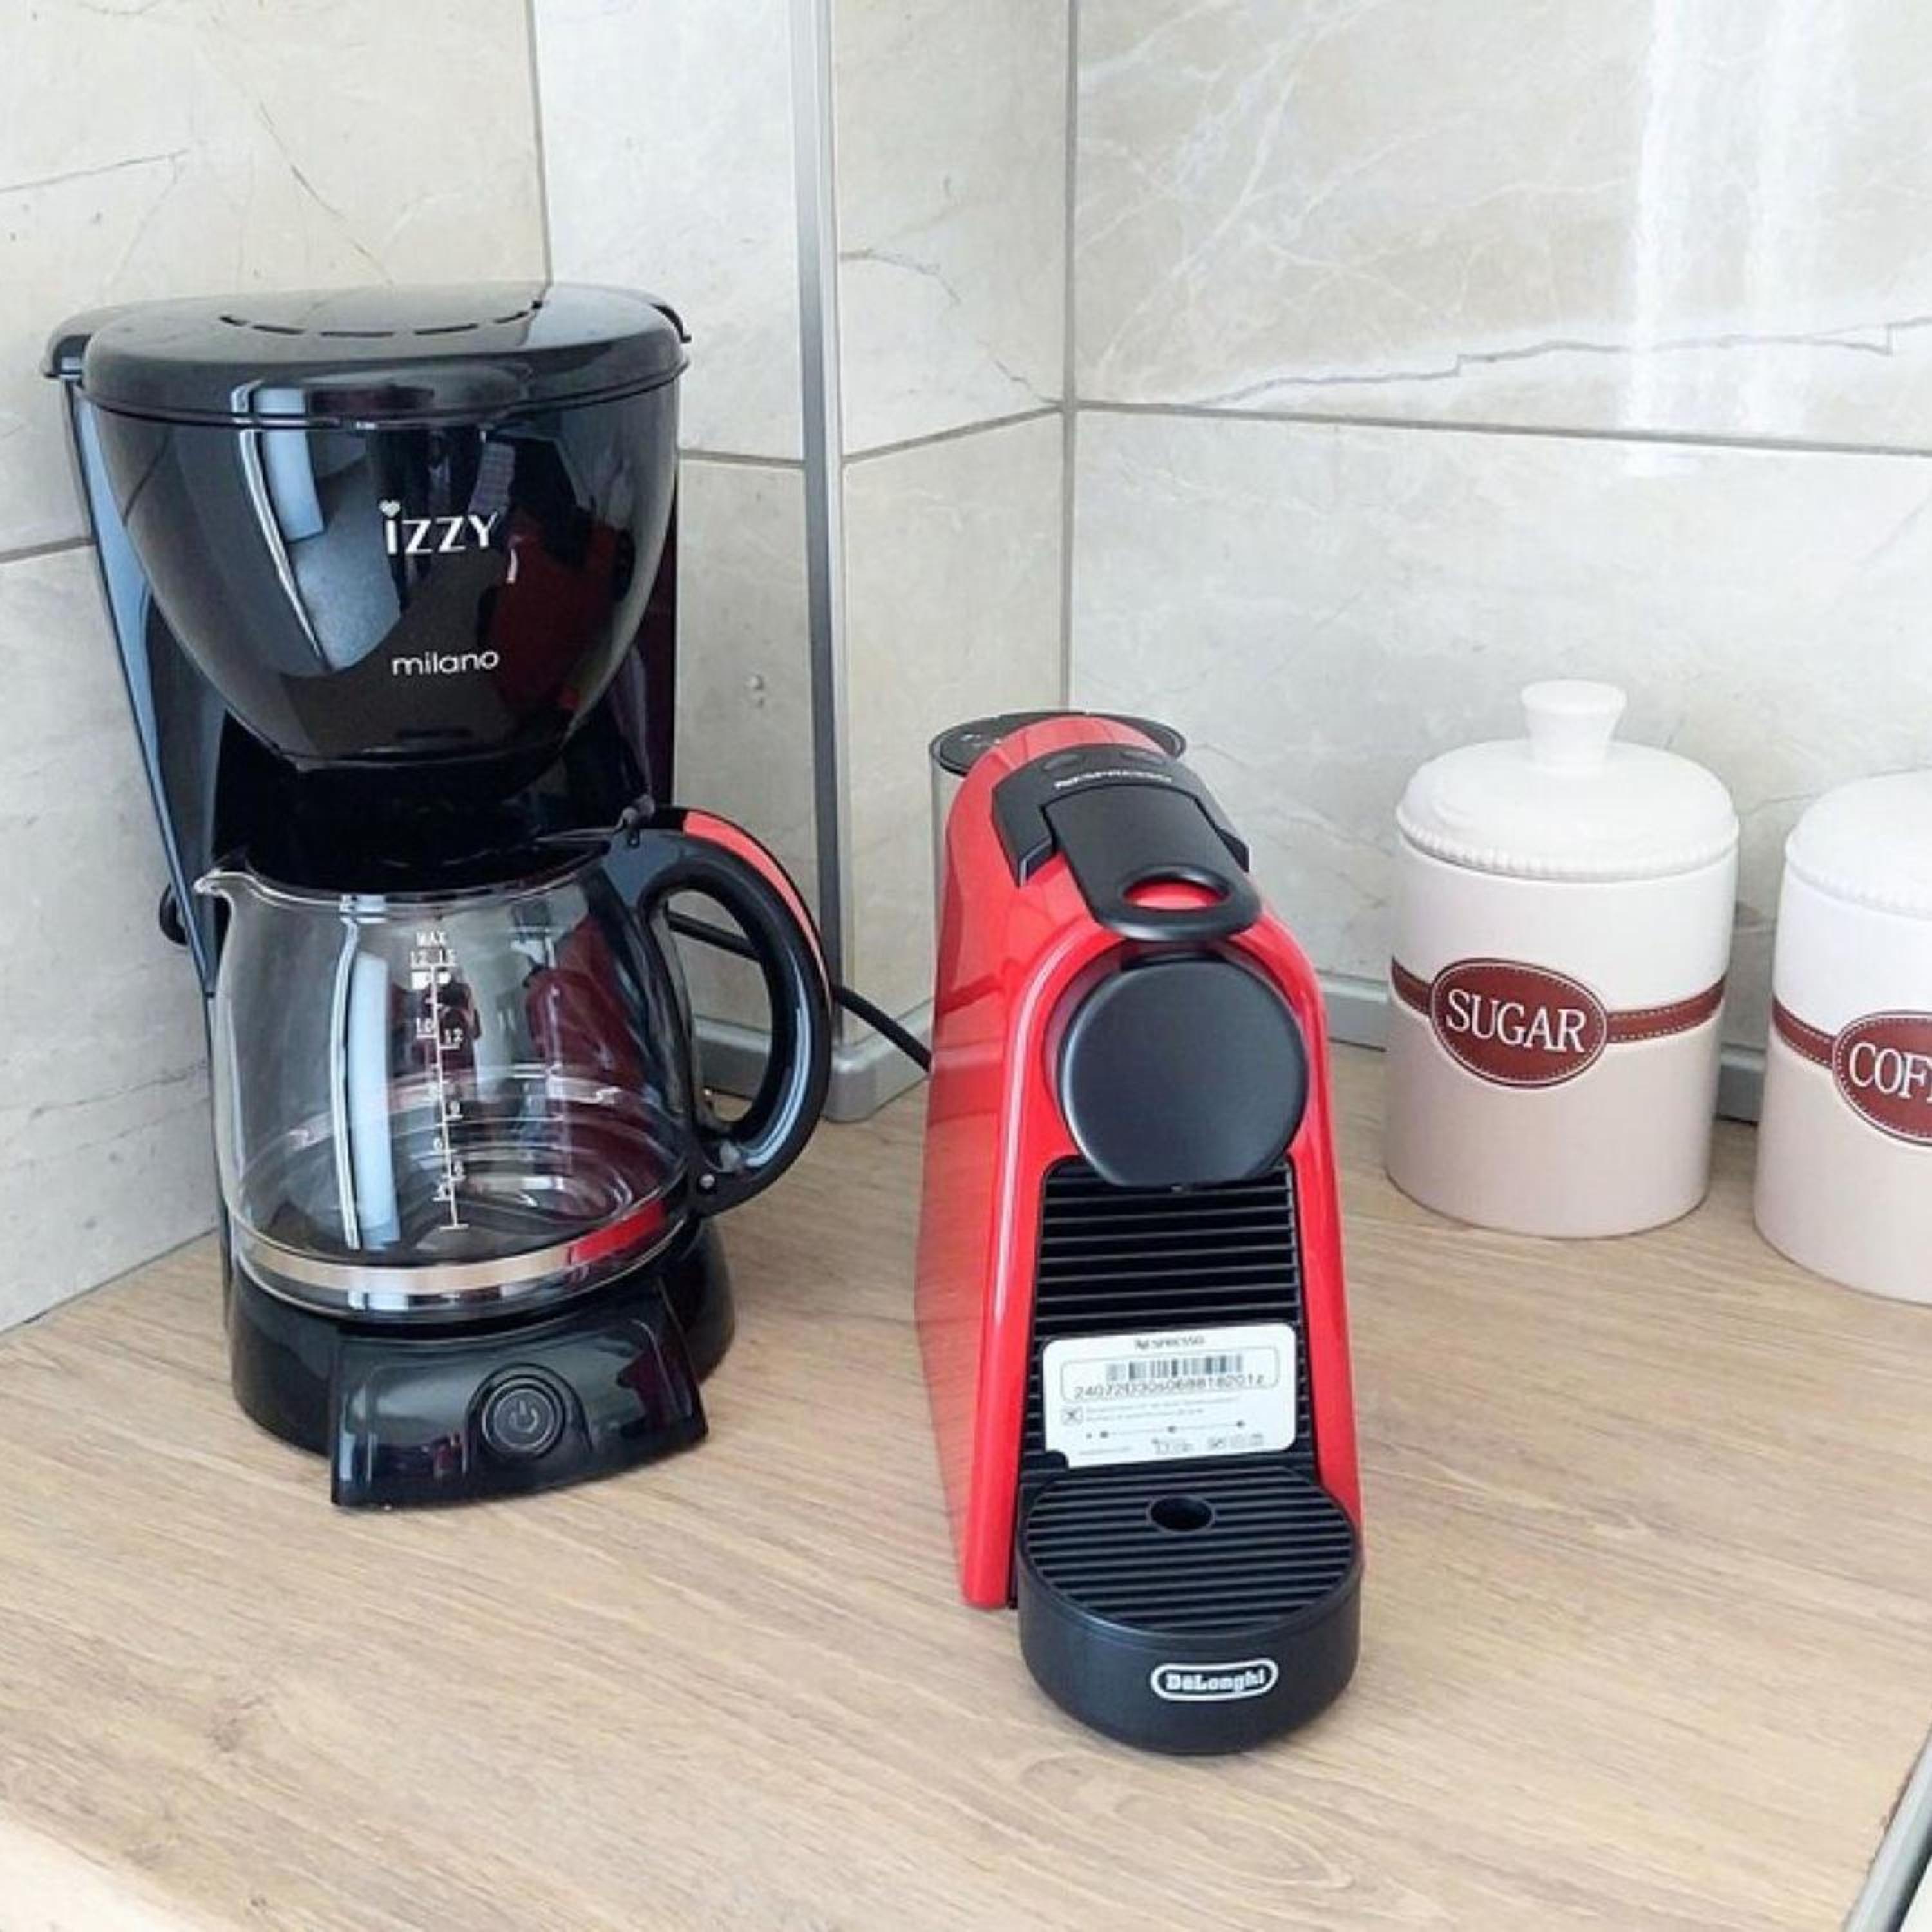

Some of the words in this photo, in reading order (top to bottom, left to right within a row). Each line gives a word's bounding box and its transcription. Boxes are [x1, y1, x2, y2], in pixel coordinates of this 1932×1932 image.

[392, 651, 500, 676] milano
[1446, 989, 1586, 1053] SUGAR
[1848, 1042, 1932, 1104] COF
